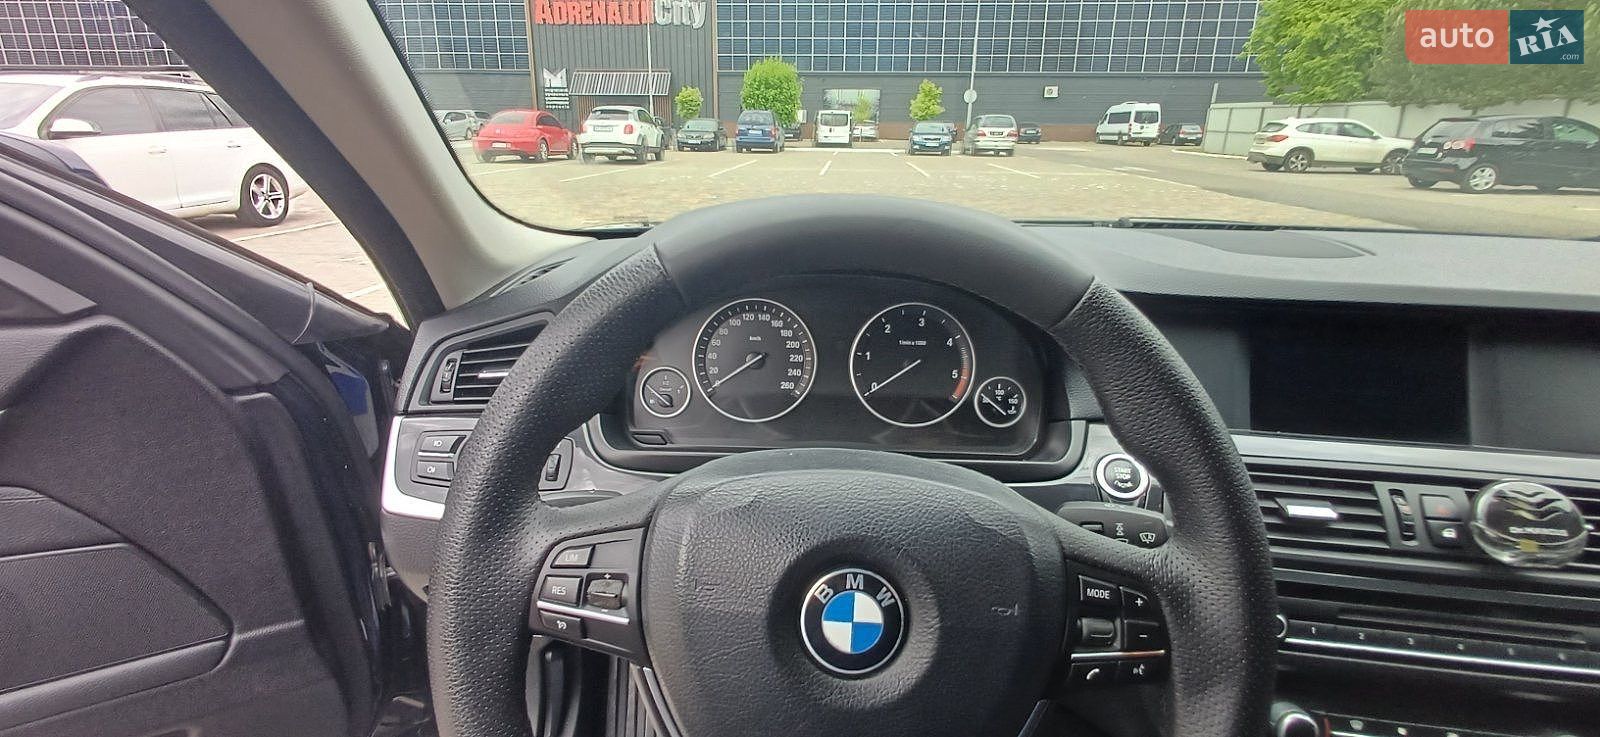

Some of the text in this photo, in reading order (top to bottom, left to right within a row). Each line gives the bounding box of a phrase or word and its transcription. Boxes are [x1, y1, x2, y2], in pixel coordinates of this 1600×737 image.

[918, 318, 925, 327] 3
[884, 325, 891, 334] 2
[946, 338, 953, 347] 4
[865, 352, 871, 360] 1
[952, 370, 958, 379] 5
[551, 585, 567, 596] RES
[814, 573, 896, 608] BMW
[1086, 588, 1110, 600] MODE
